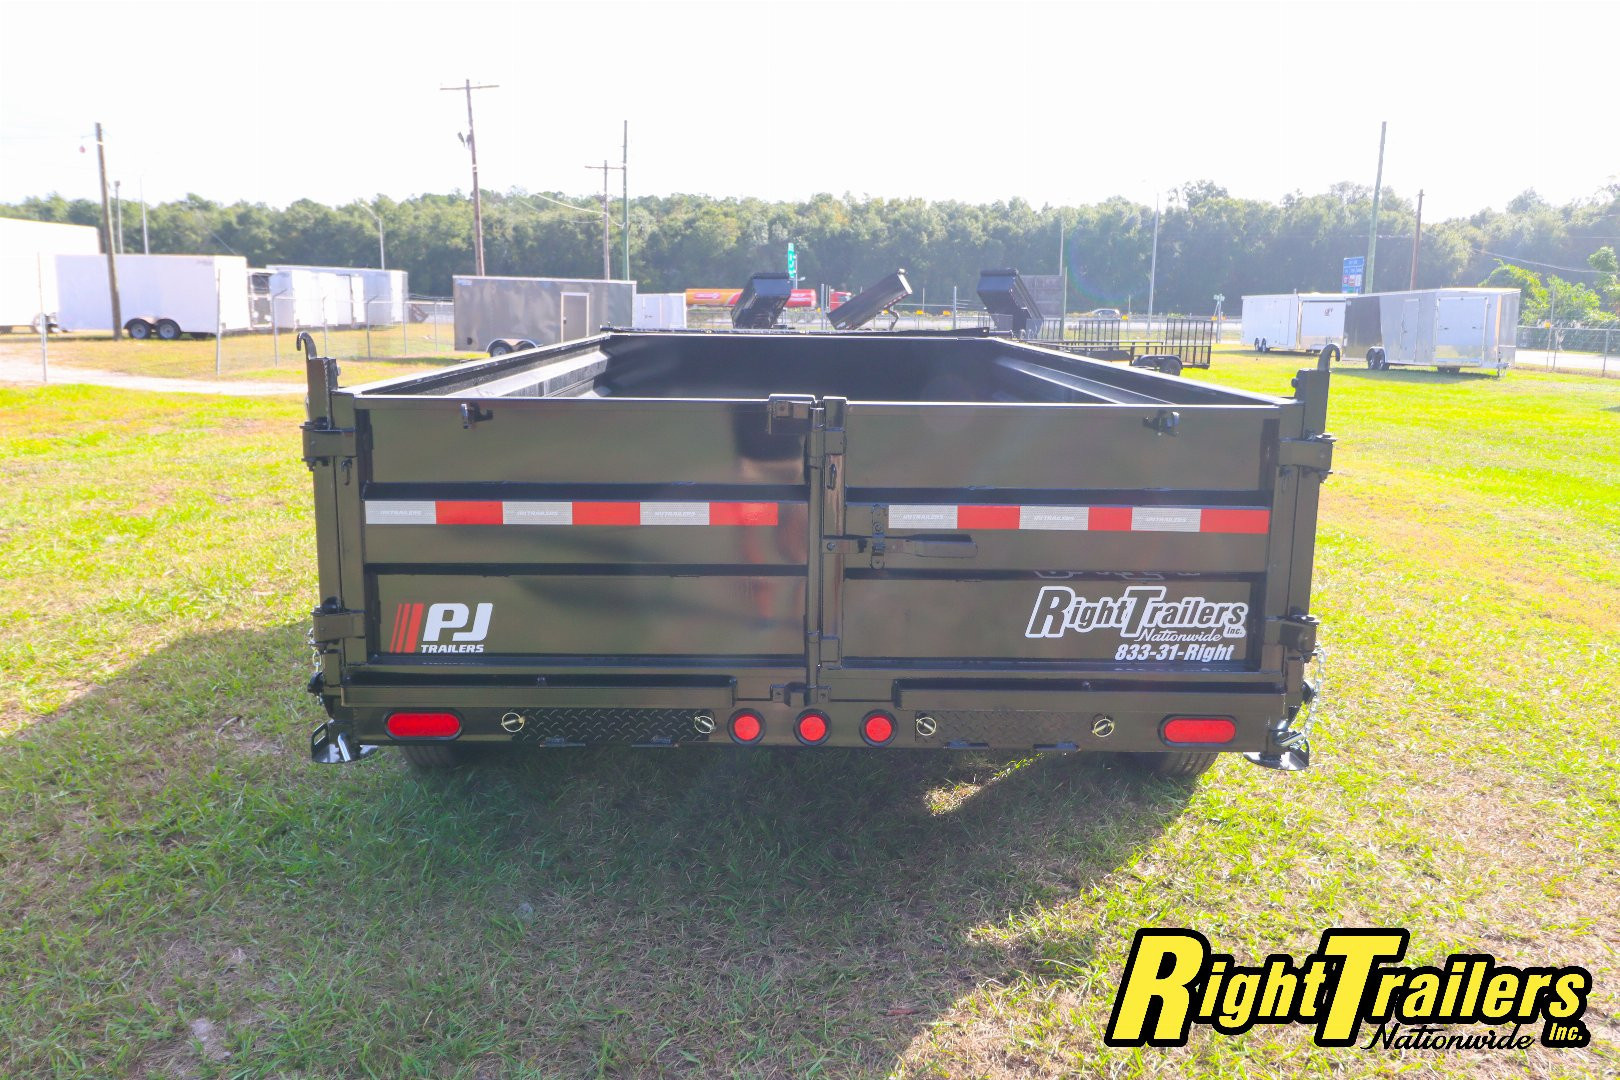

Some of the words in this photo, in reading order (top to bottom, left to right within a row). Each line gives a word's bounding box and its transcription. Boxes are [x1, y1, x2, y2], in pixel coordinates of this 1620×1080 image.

[423, 602, 493, 641] PJ
[1134, 628, 1222, 642] Nationwide
[1224, 626, 1245, 637] Inc.
[421, 644, 484, 653] TRAILERS
[1115, 643, 1235, 662] 833-31-Right
